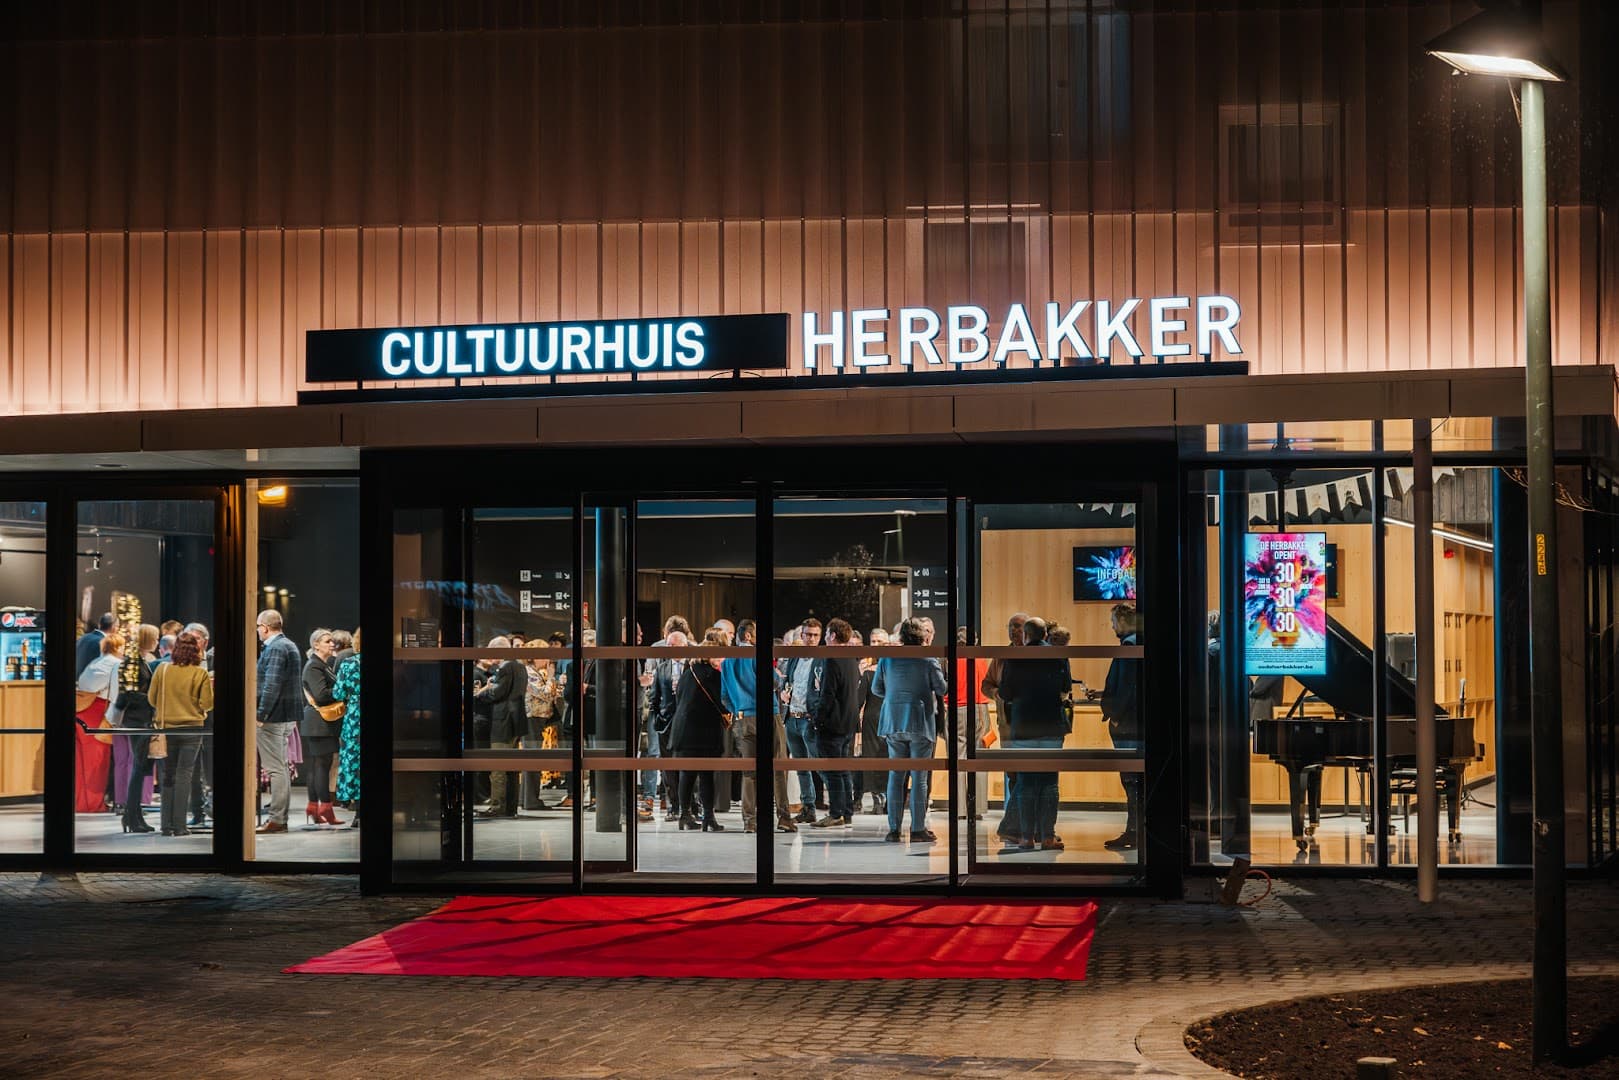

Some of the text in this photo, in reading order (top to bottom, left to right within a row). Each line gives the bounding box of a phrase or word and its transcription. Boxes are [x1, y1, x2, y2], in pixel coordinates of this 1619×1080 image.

[381, 295, 1242, 376] CULTUURHUIS HERBAKKER
[1260, 541, 1269, 550] DE
[1274, 551, 1296, 559] OPENT
[1275, 562, 1295, 583] 30
[1275, 587, 1295, 607] 30
[1275, 612, 1295, 632] 30
